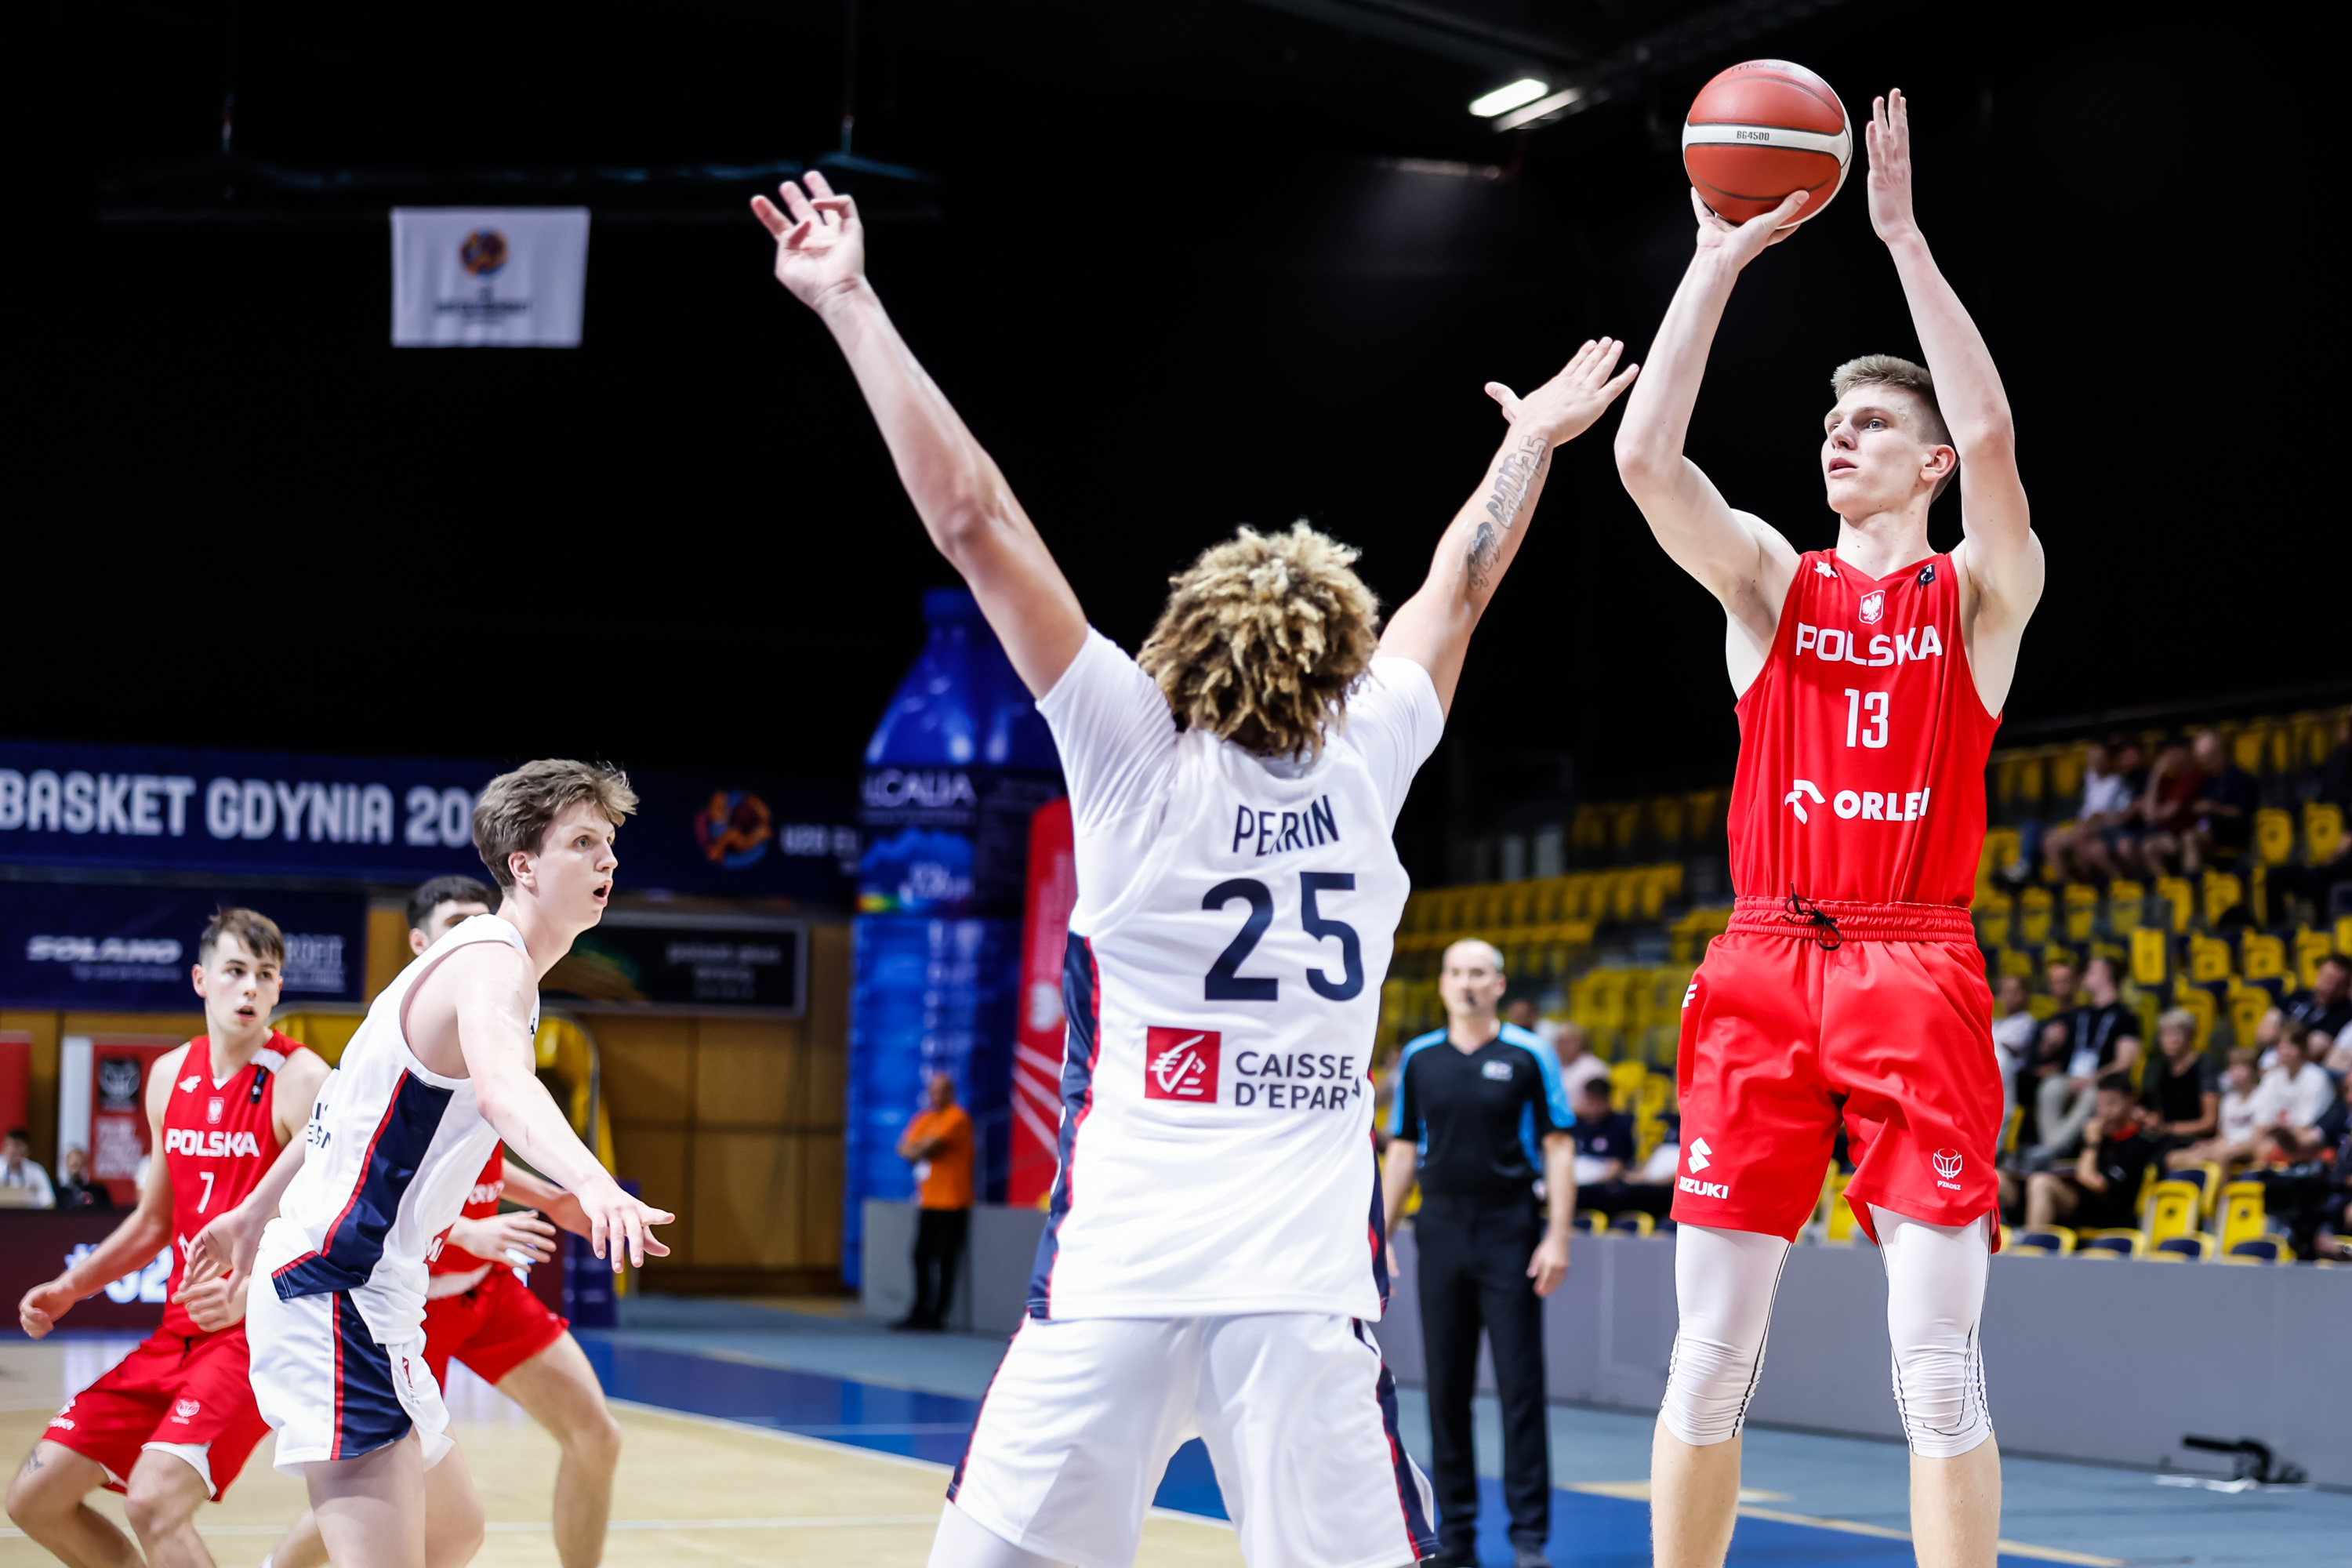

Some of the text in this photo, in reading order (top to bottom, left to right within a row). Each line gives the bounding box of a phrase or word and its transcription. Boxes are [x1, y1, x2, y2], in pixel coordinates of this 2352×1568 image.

[1737, 130, 1770, 141] BG4500
[1795, 622, 1943, 667] POLSKA
[1844, 688, 1889, 749] 13
[0, 768, 481, 848] BASKET GDYNIA 20
[1202, 871, 1364, 1001] 25
[1236, 1051, 1355, 1080] CAISSE
[1236, 1079, 1361, 1111] D'EPAR
[165, 1128, 260, 1157] POLSKA
[197, 1171, 215, 1214] 7
